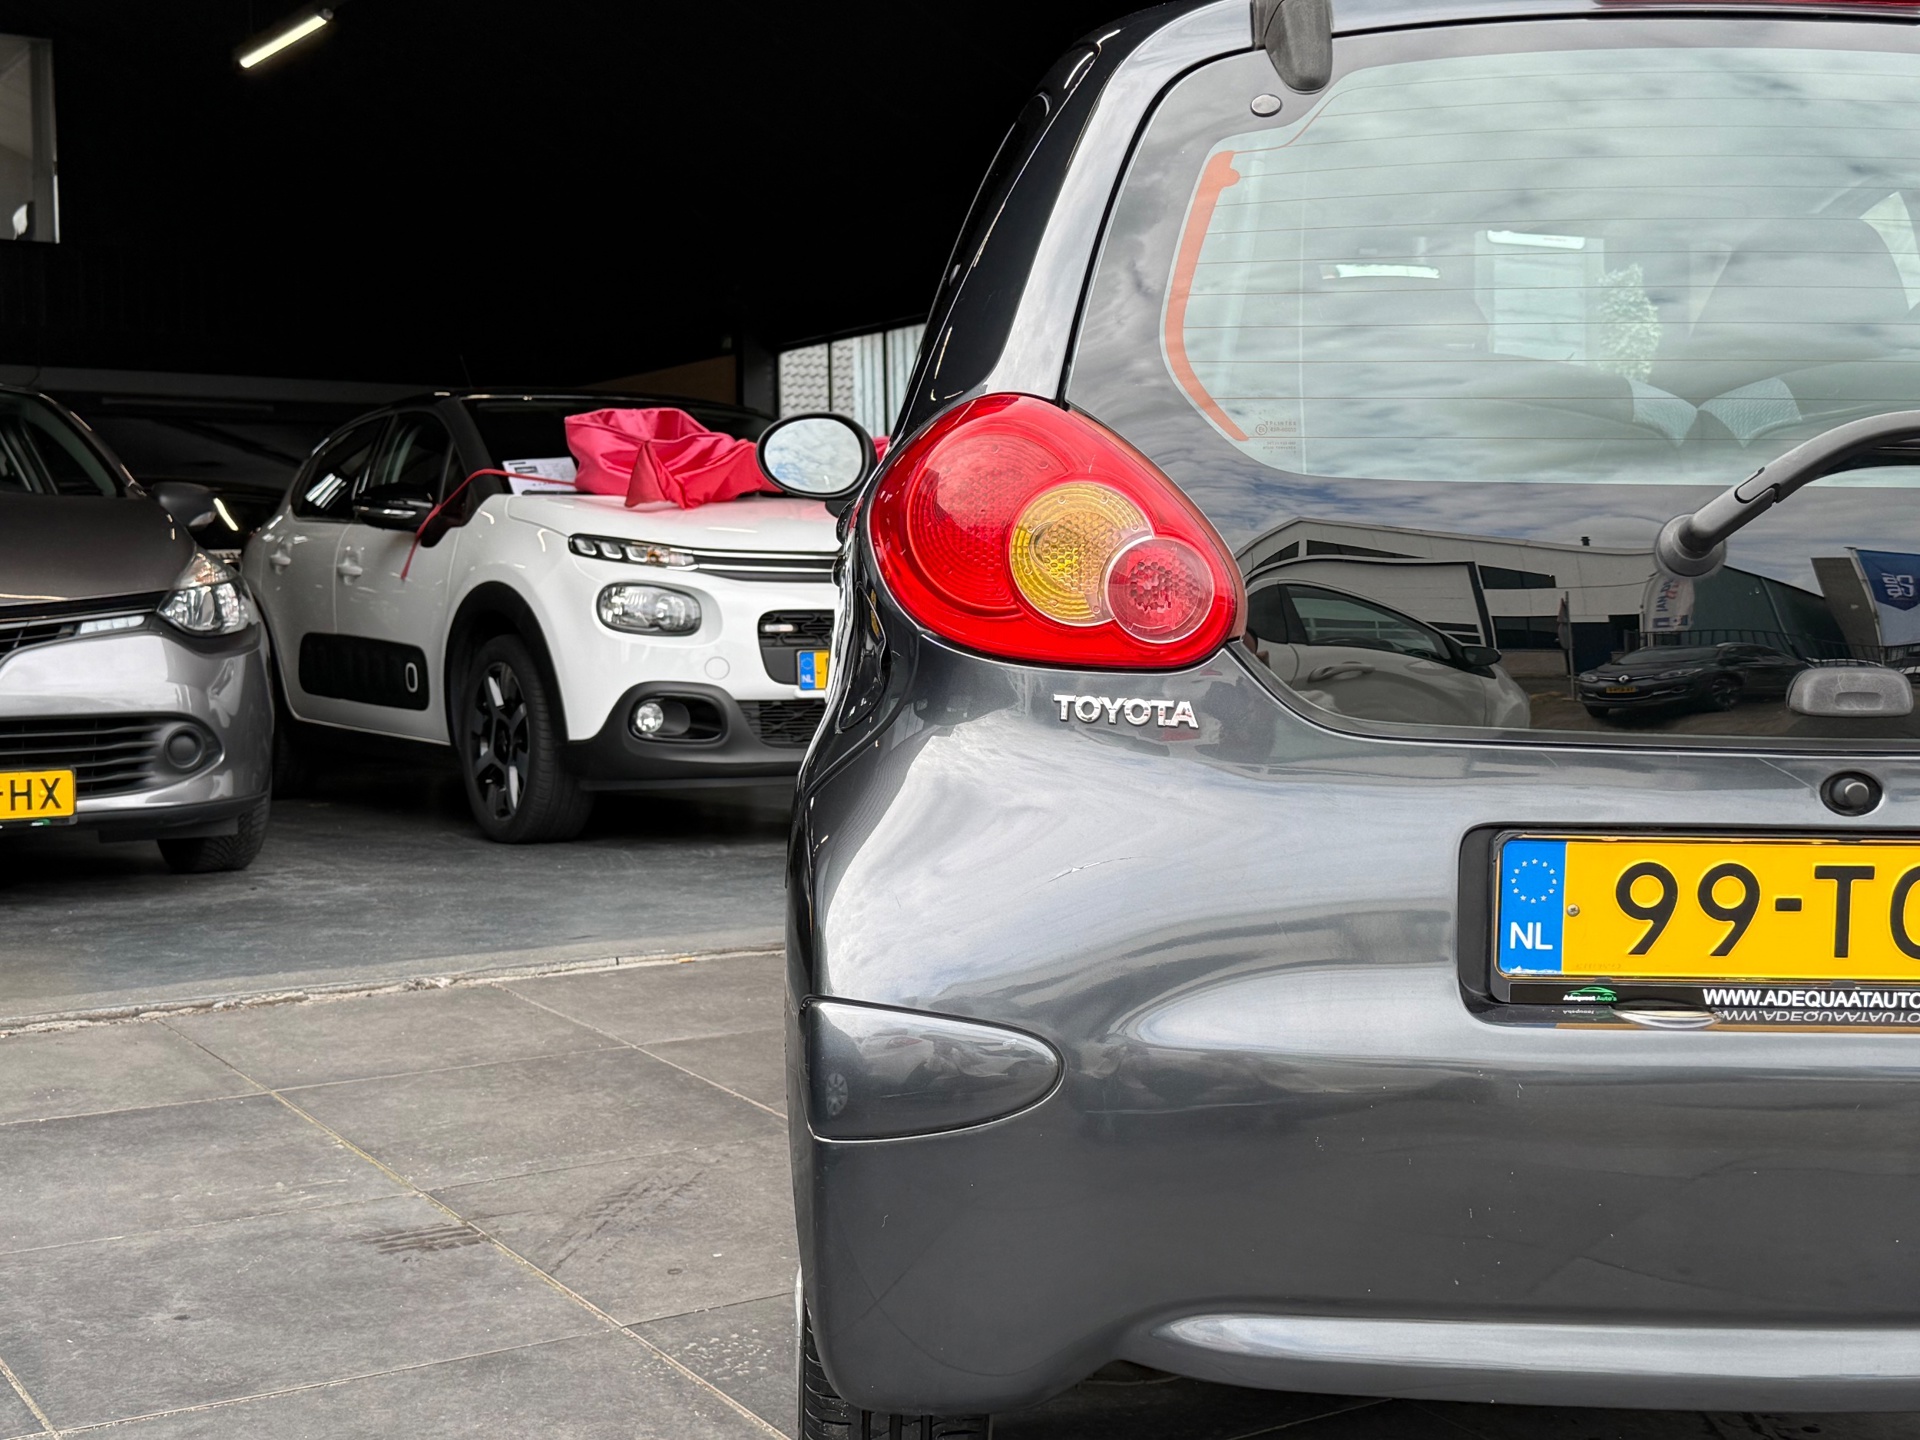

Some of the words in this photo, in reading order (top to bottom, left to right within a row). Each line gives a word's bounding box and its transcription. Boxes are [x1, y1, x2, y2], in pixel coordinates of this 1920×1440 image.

[801, 674, 814, 683] NL
[1053, 693, 1199, 729] TOYOTA
[1509, 921, 1554, 950] NL
